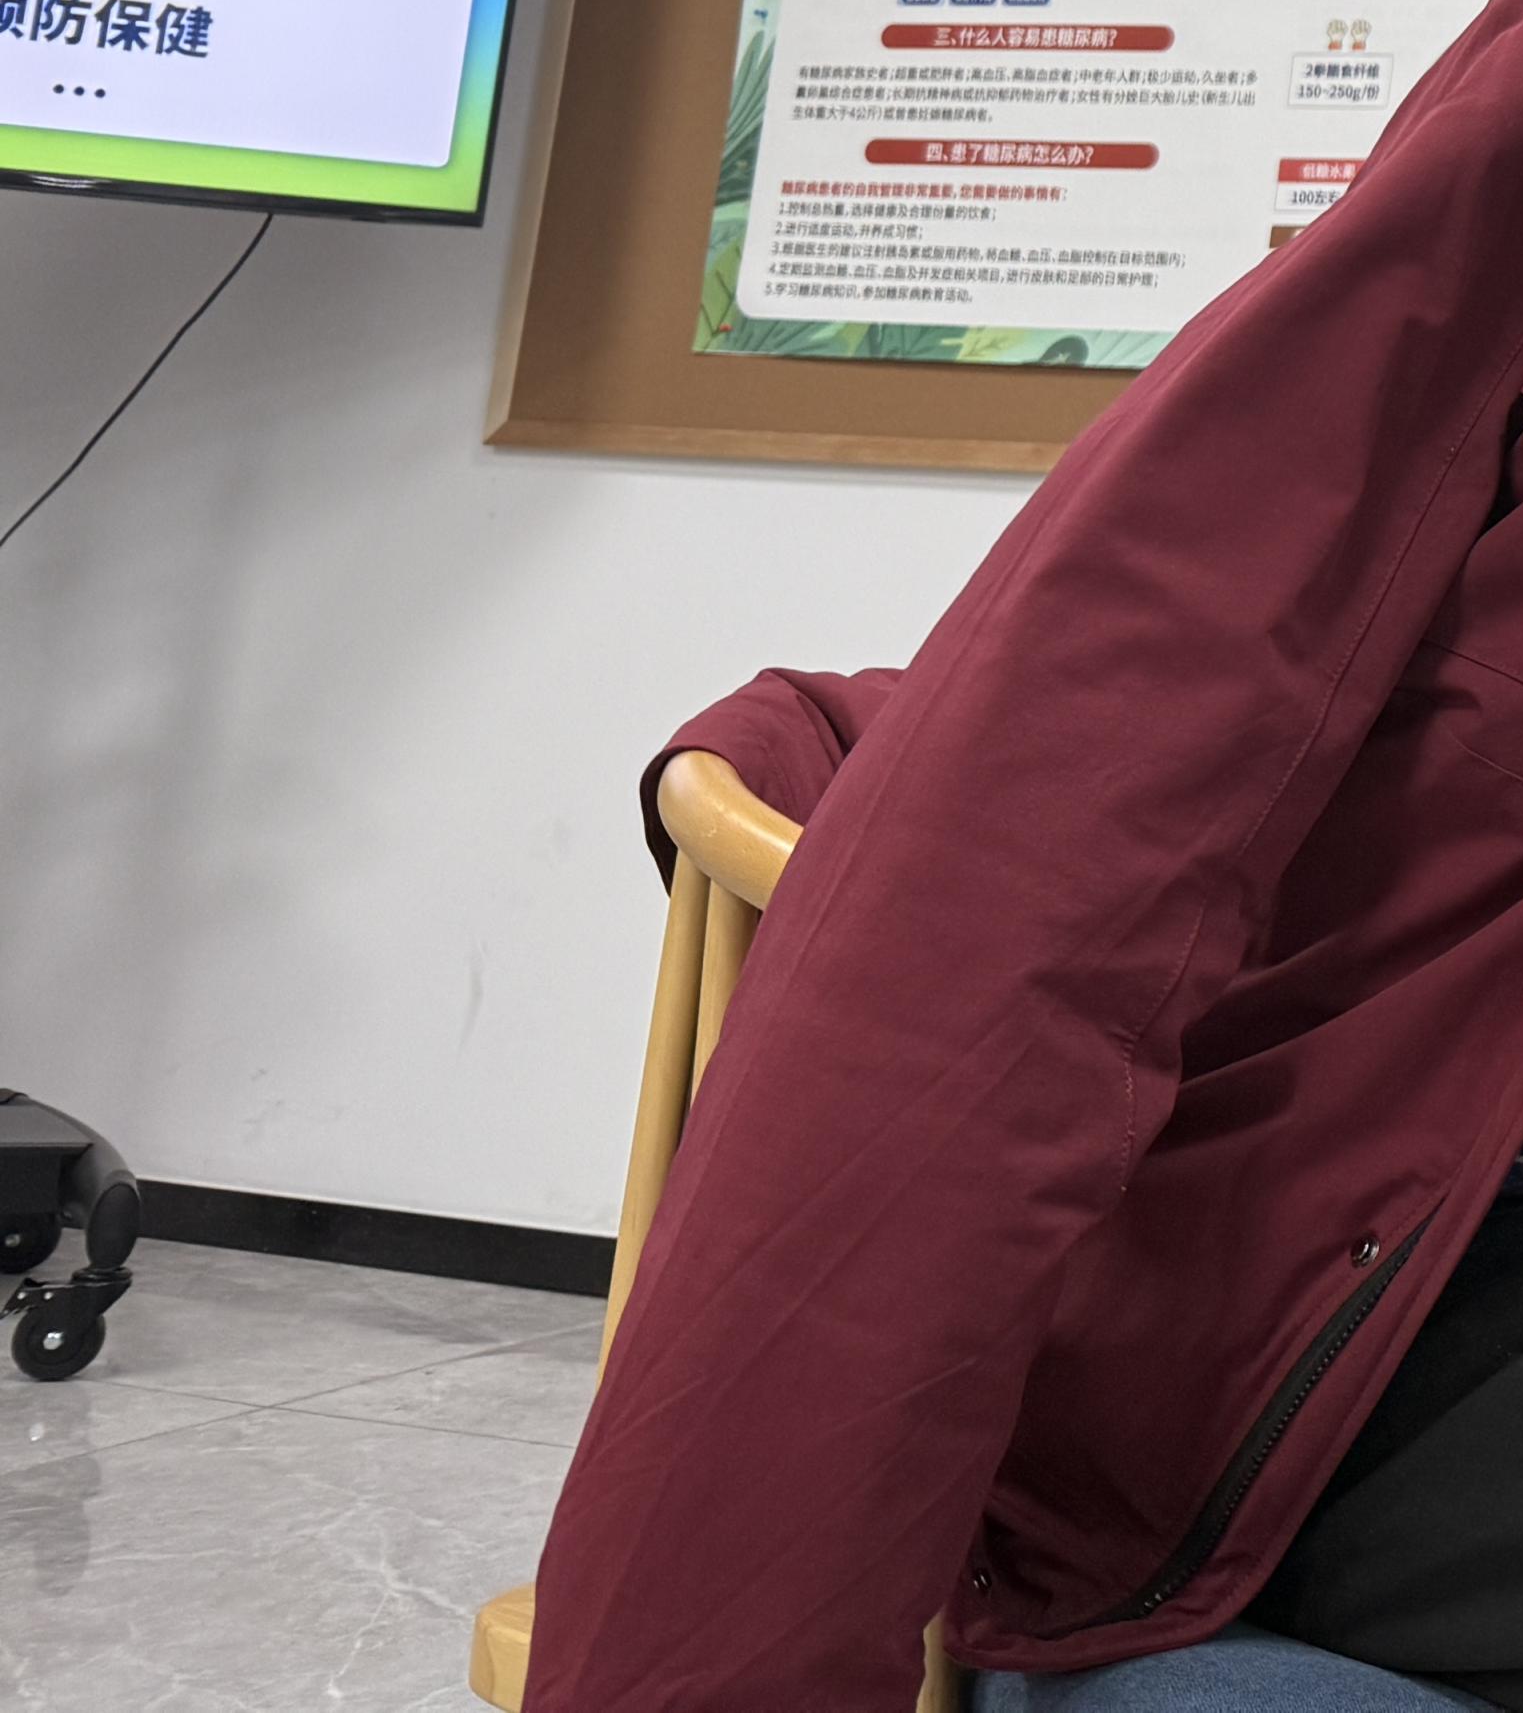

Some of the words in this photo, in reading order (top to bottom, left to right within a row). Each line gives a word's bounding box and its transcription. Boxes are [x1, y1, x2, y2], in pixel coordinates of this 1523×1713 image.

[933, 27, 1119, 49] 三、什么人容易患糖尿病？
[925, 142, 1095, 165] 四、患了糖尿病怎么办？
